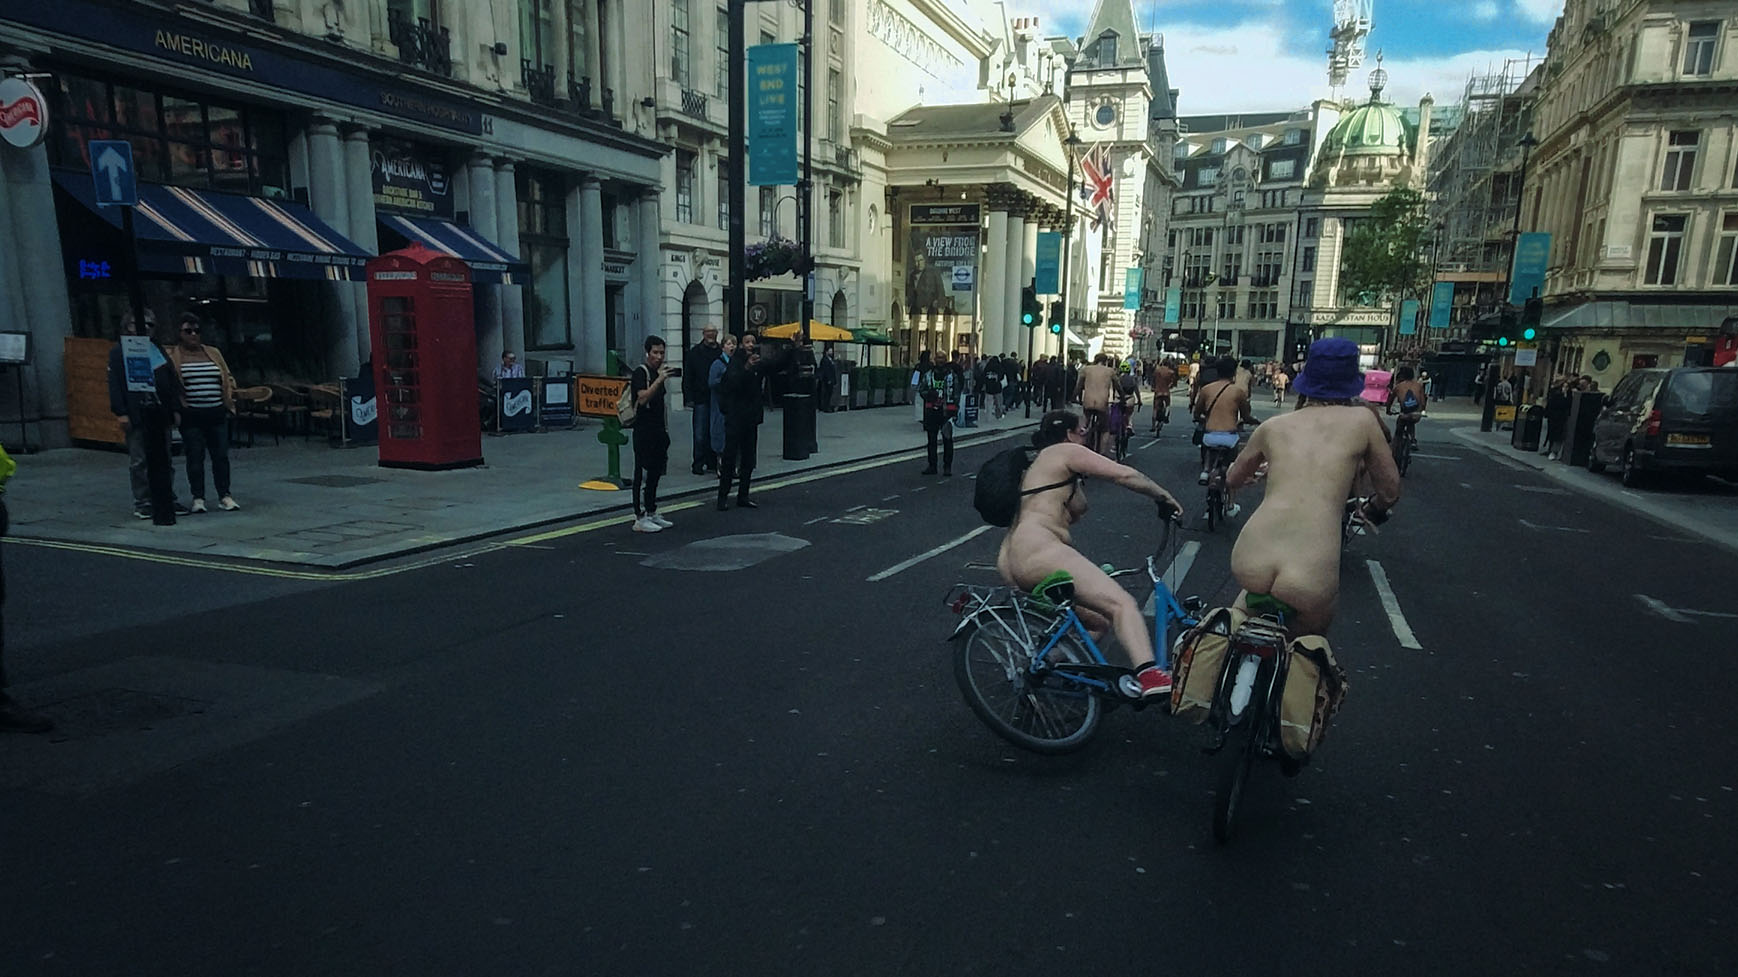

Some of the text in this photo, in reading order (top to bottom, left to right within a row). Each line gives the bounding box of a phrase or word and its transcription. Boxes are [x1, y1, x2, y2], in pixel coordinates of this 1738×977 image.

[154, 30, 254, 71] AMERICANA
[378, 156, 425, 182] AMERICANA
[926, 237, 931, 247] A
[932, 237, 953, 247] VIEW
[928, 247, 976, 257] THE BRIDGE
[581, 383, 619, 396] Diverted
[585, 398, 615, 410] traffic
